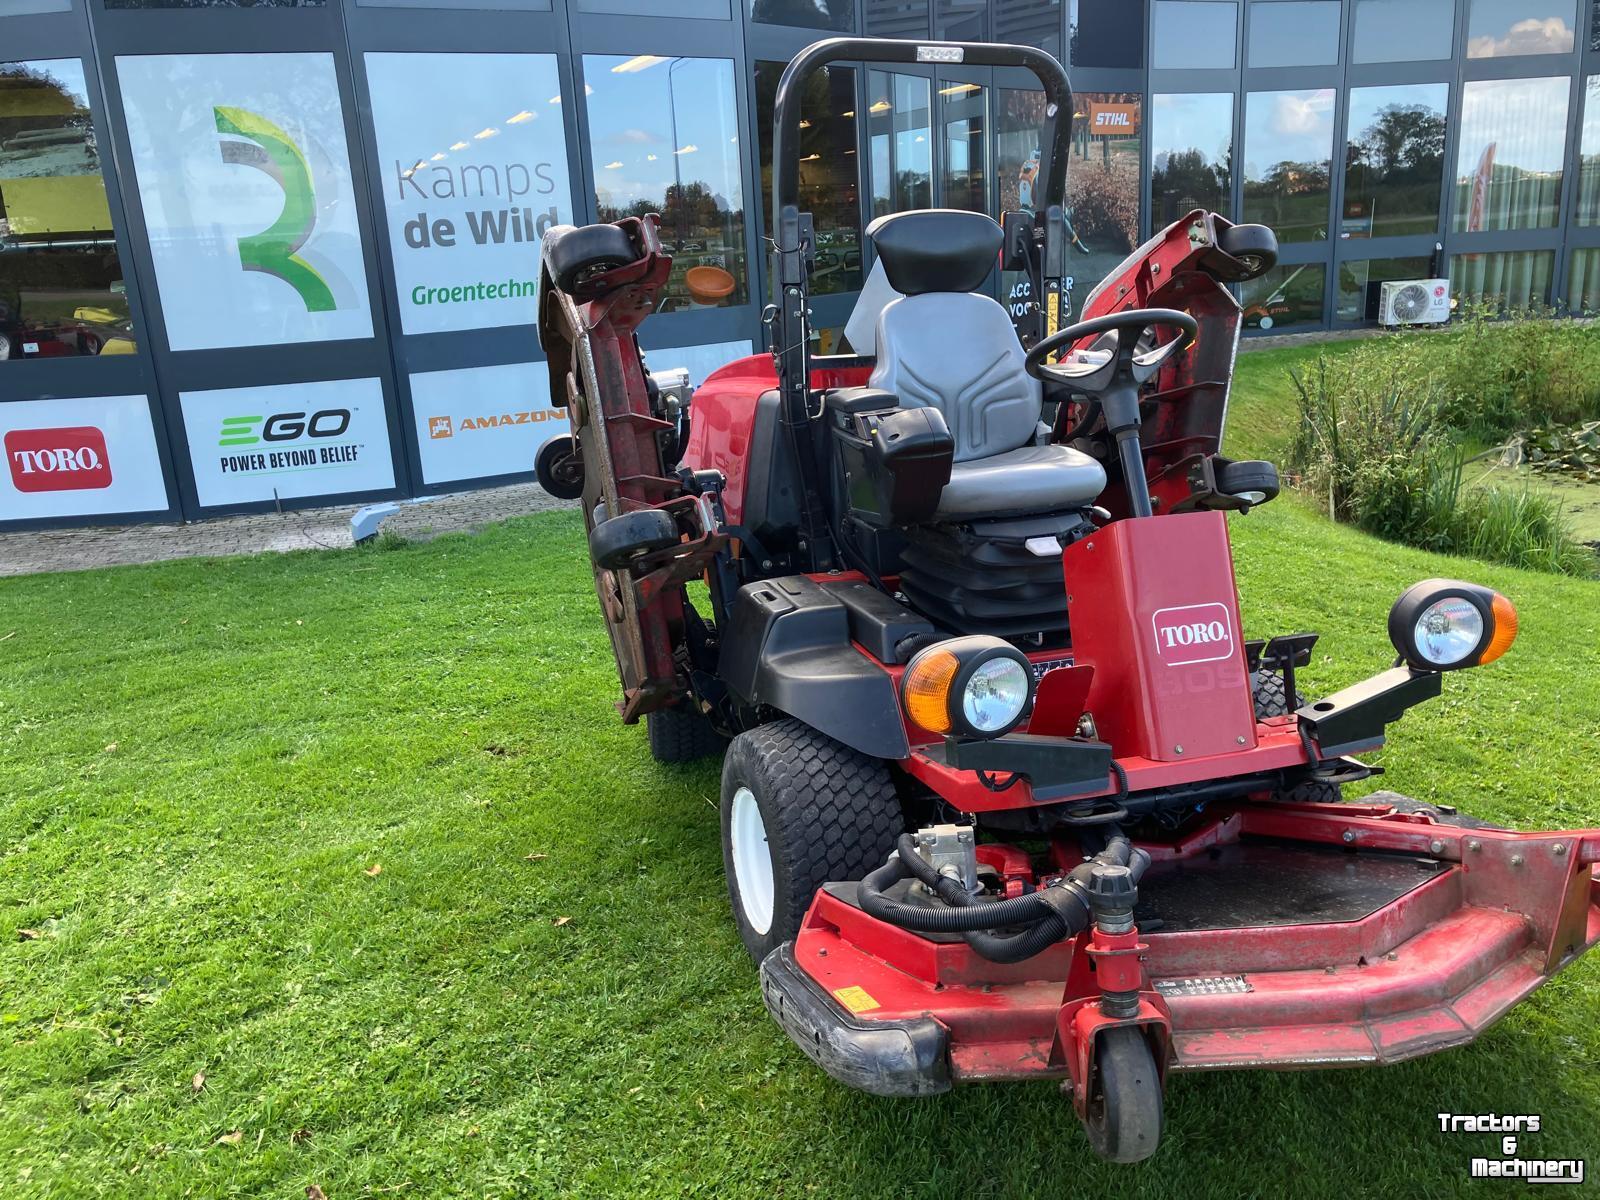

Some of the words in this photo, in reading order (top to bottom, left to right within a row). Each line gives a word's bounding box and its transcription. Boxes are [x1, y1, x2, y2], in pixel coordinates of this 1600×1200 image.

[1095, 112, 1130, 126] STIHL
[396, 159, 555, 203] Kamps
[404, 212, 456, 249] de
[465, 206, 559, 245] Wild
[221, 453, 267, 473] POWER
[269, 448, 317, 469] BEYOND
